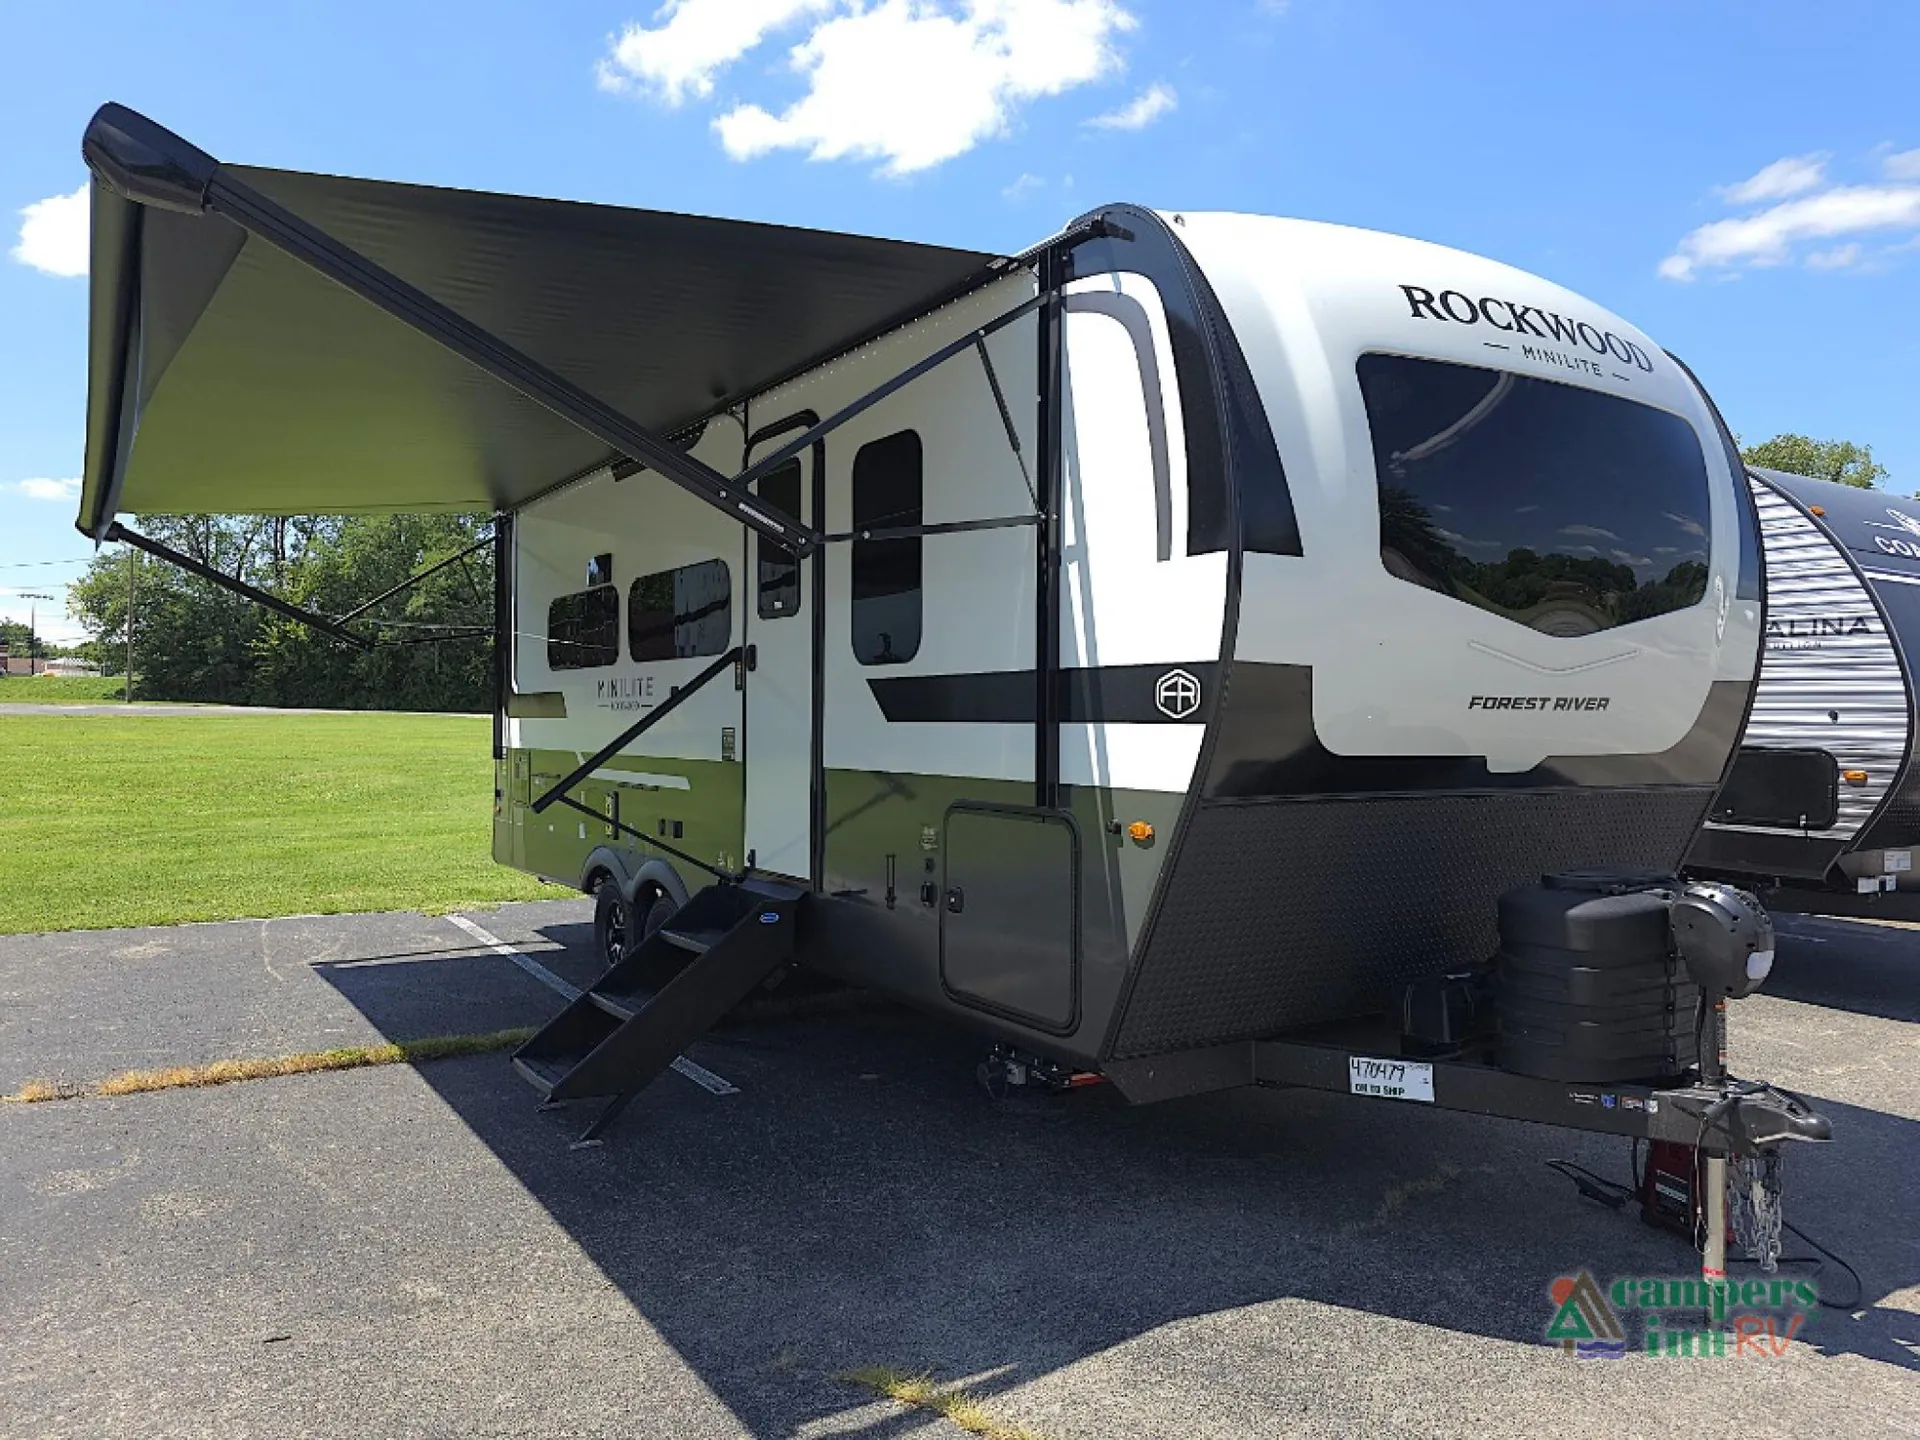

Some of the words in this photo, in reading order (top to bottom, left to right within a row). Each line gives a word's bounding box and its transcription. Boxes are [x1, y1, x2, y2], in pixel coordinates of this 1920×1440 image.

[1398, 284, 1654, 373] ROCKWOOD
[1522, 344, 1603, 377] MINILITE
[597, 676, 654, 699] MINILITE
[1468, 696, 1551, 710] FOREST
[1552, 696, 1611, 711] RIVER
[1351, 1058, 1405, 1082] 470479
